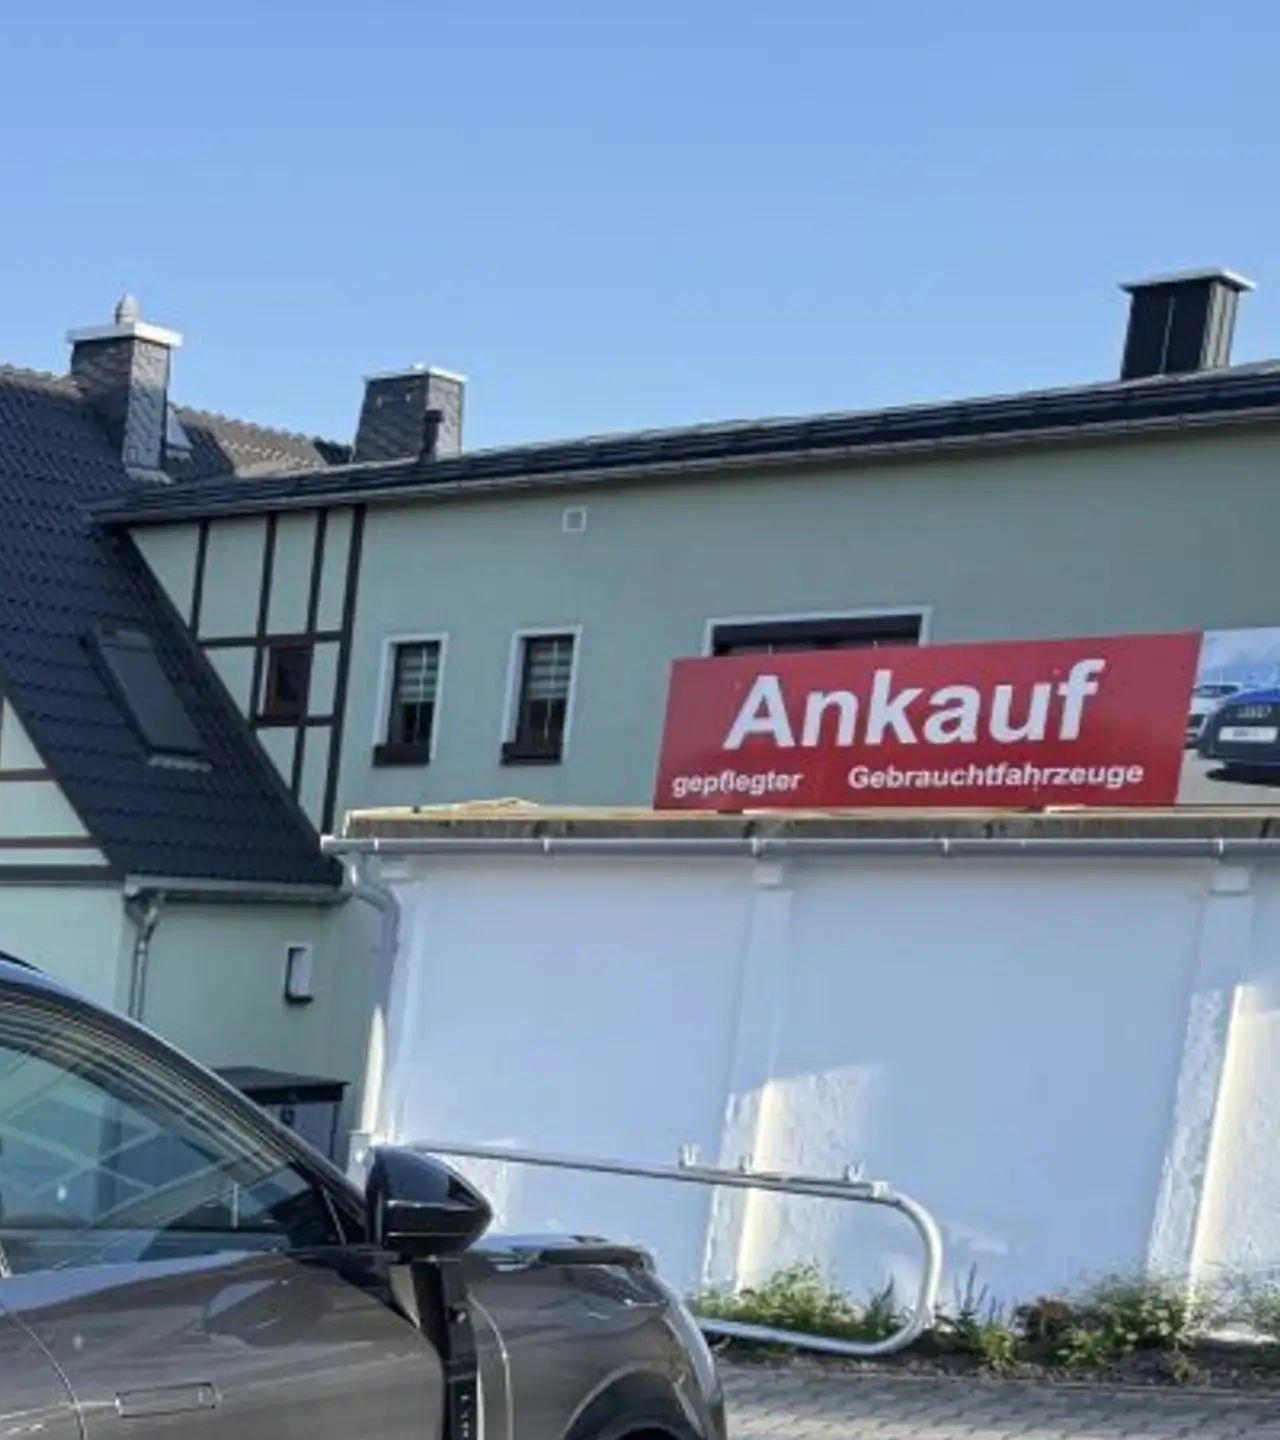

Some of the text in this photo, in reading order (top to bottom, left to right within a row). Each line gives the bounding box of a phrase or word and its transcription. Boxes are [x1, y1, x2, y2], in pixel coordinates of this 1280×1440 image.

[723, 658, 1106, 751] Ankauf
[671, 761, 1144, 799] gepflegter Gebrauchtfahrzeuge
